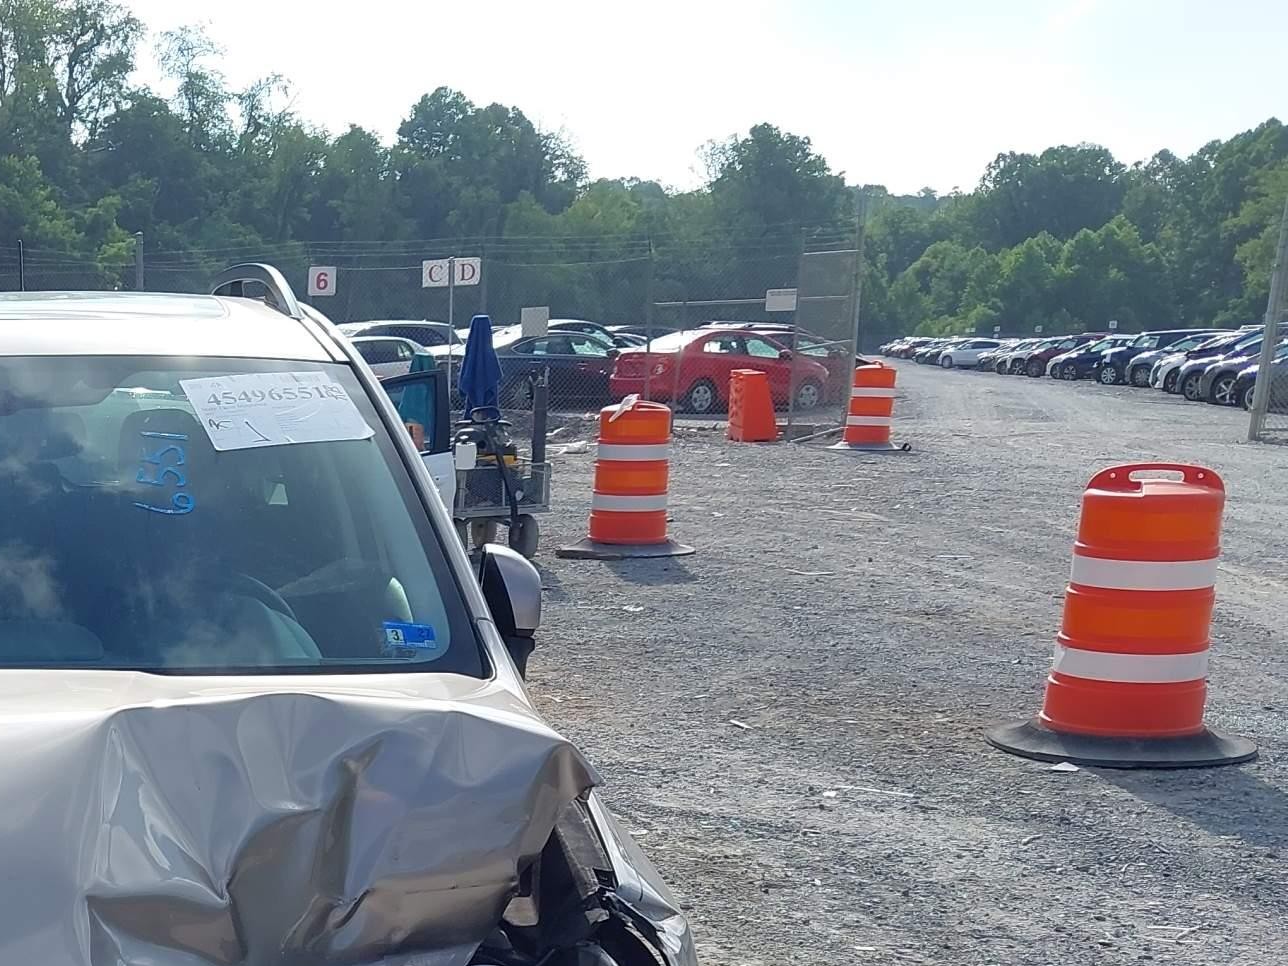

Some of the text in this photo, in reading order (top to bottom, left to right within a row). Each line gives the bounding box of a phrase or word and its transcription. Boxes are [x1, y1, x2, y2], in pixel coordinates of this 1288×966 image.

[315, 271, 329, 291] 6
[428, 264, 443, 283] C
[460, 262, 476, 282] D
[207, 386, 326, 406] 45496551
[391, 629, 400, 641] 3
